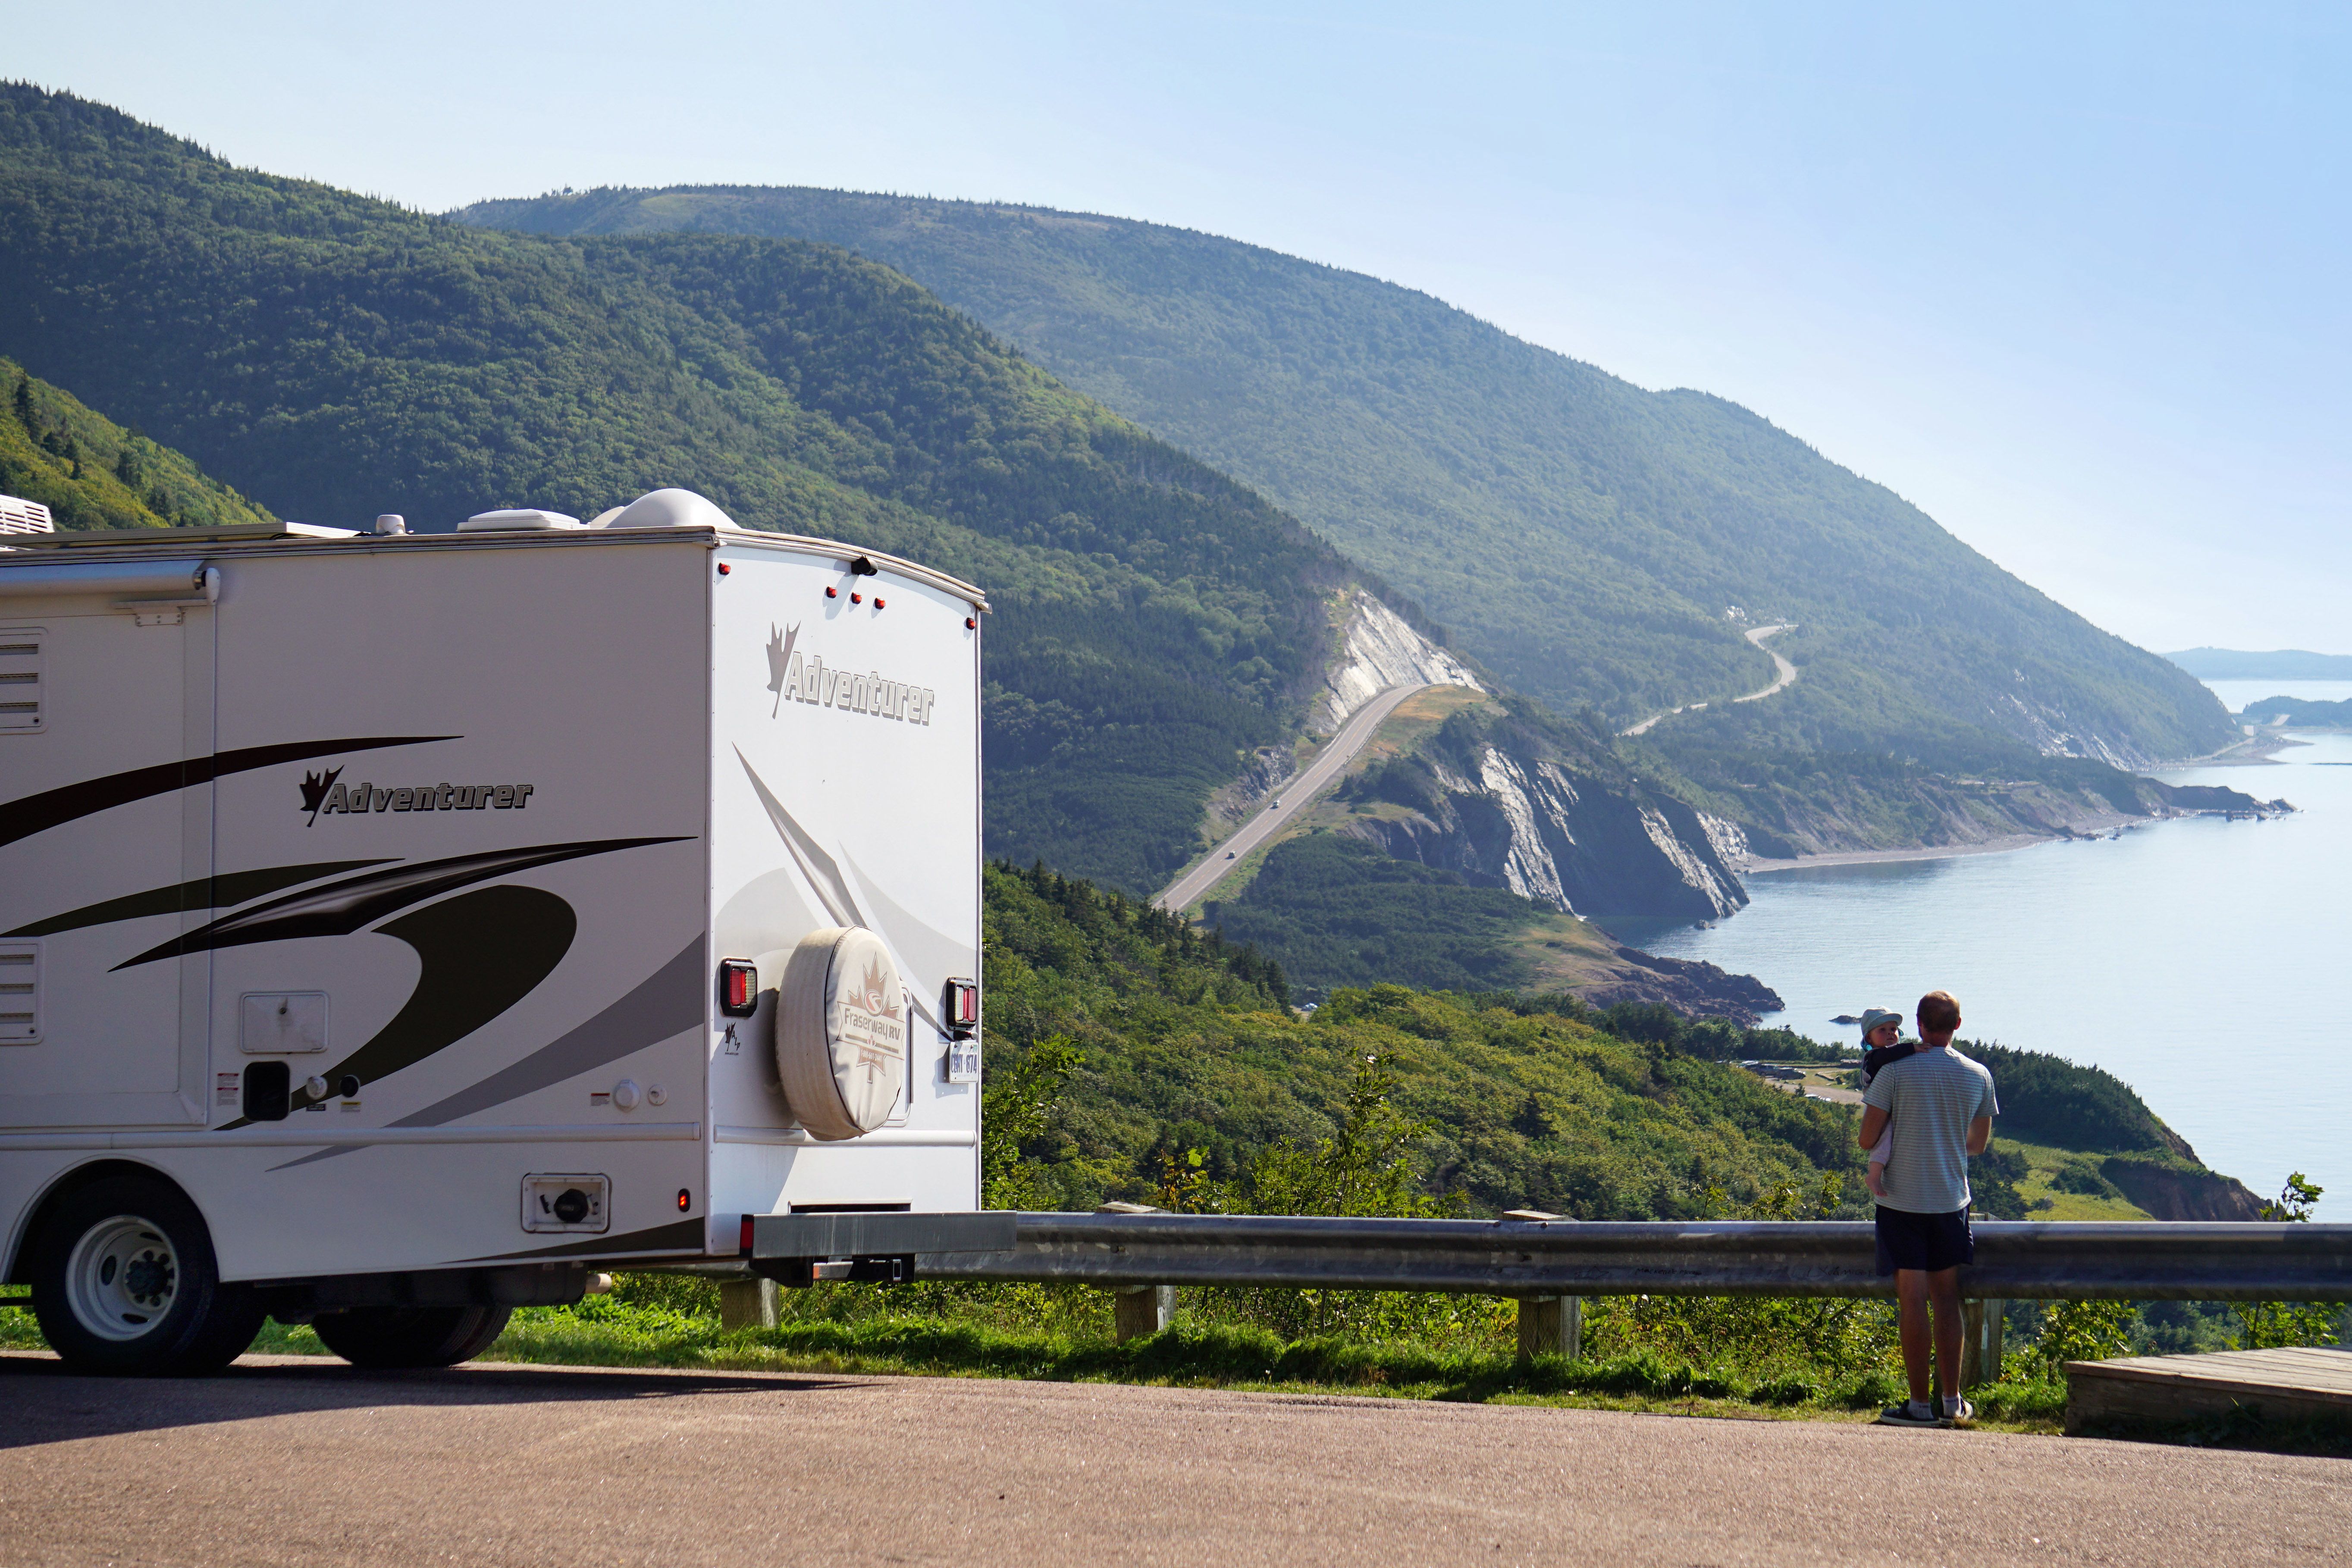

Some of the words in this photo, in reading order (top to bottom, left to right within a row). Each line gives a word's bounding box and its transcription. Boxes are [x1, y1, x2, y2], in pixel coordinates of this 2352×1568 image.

[784, 651, 934, 726] Adventurer
[323, 783, 533, 814] Adventurer
[845, 1007, 888, 1040] Fraserway
[889, 1025, 900, 1041] RV
[966, 1054, 977, 1074] 874
